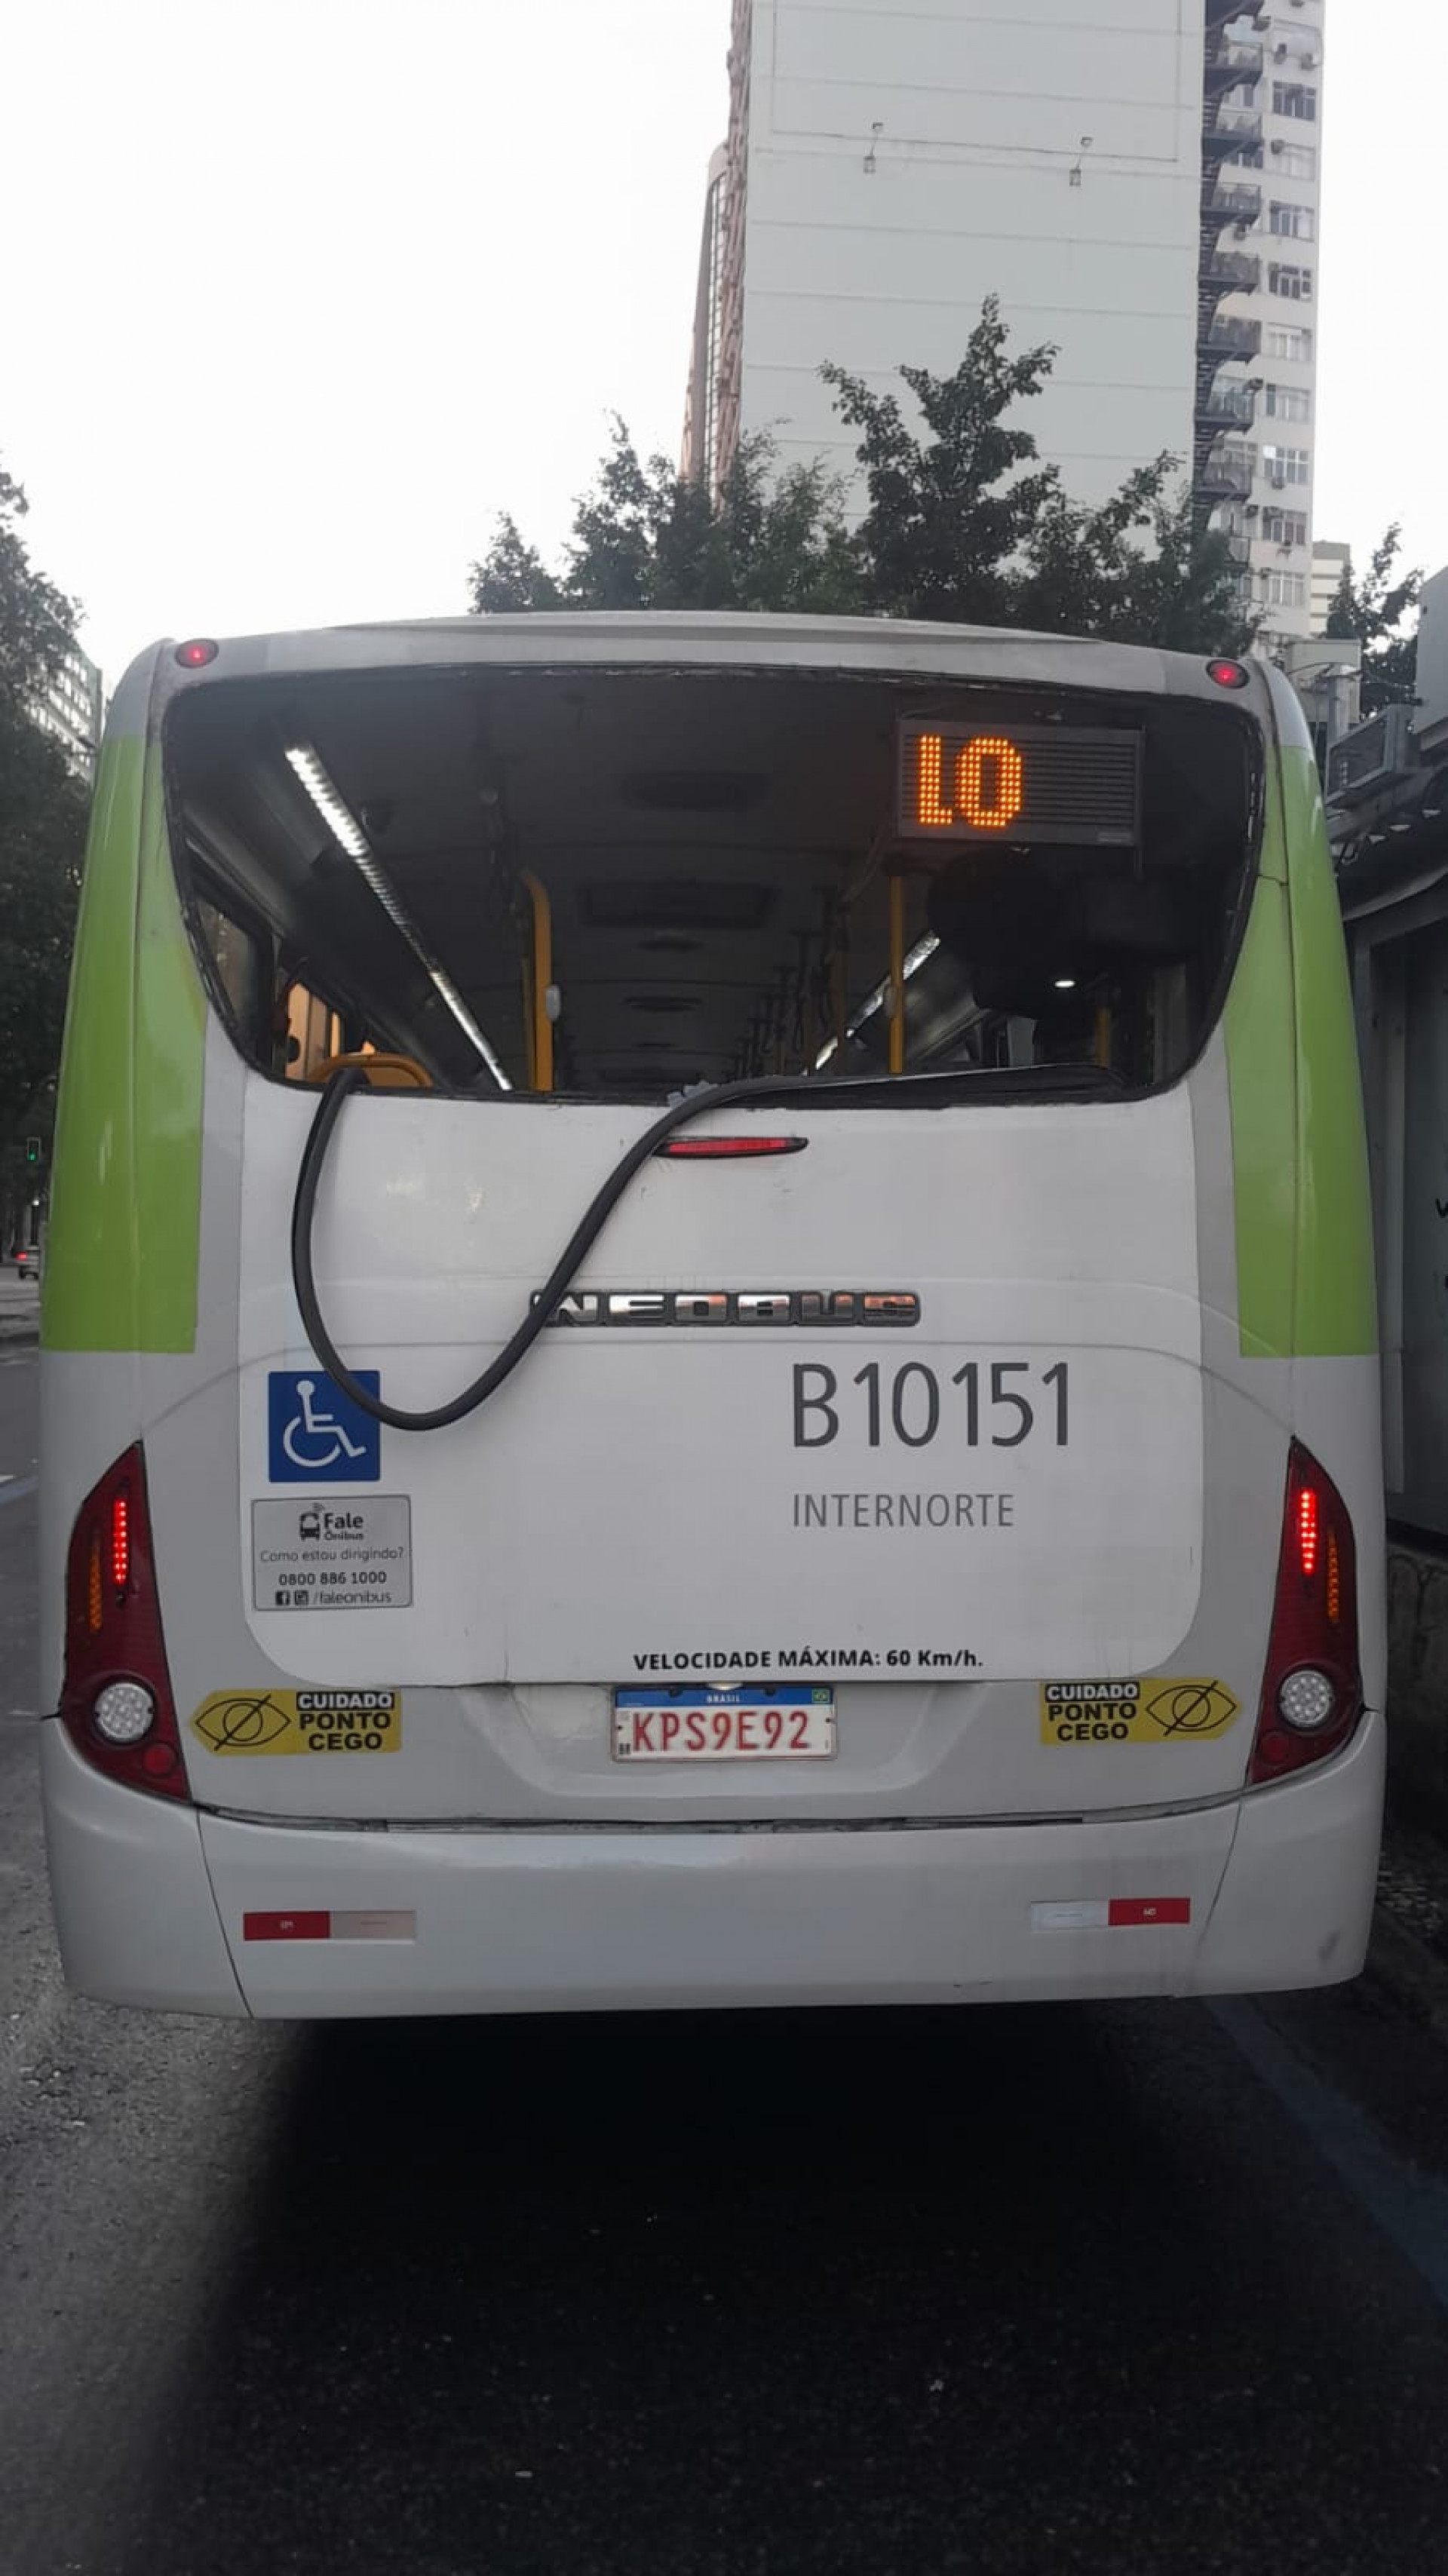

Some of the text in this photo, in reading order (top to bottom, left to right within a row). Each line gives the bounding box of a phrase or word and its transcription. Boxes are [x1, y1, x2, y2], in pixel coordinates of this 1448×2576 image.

[793, 1362, 1068, 1447] B10151
[793, 1495, 1014, 1527] INTERNORTE
[324, 1512, 364, 1529] Fale
[260, 1547, 403, 1562] Como estou dirigindo?
[278, 1571, 387, 1585] 0800 886 1000
[634, 1646, 984, 1670] VELOCIDADE MÁXIMA: 60 Km/h.
[298, 1694, 392, 1709] CUIDADO
[1047, 1685, 1139, 1700] CUIDADO
[299, 1712, 391, 1730] PONTO
[1048, 1703, 1137, 1721] PONTO
[632, 1710, 810, 1752] KPS9E92
[1057, 1722, 1129, 1741] CEGO
[308, 1733, 382, 1750] CEGO
